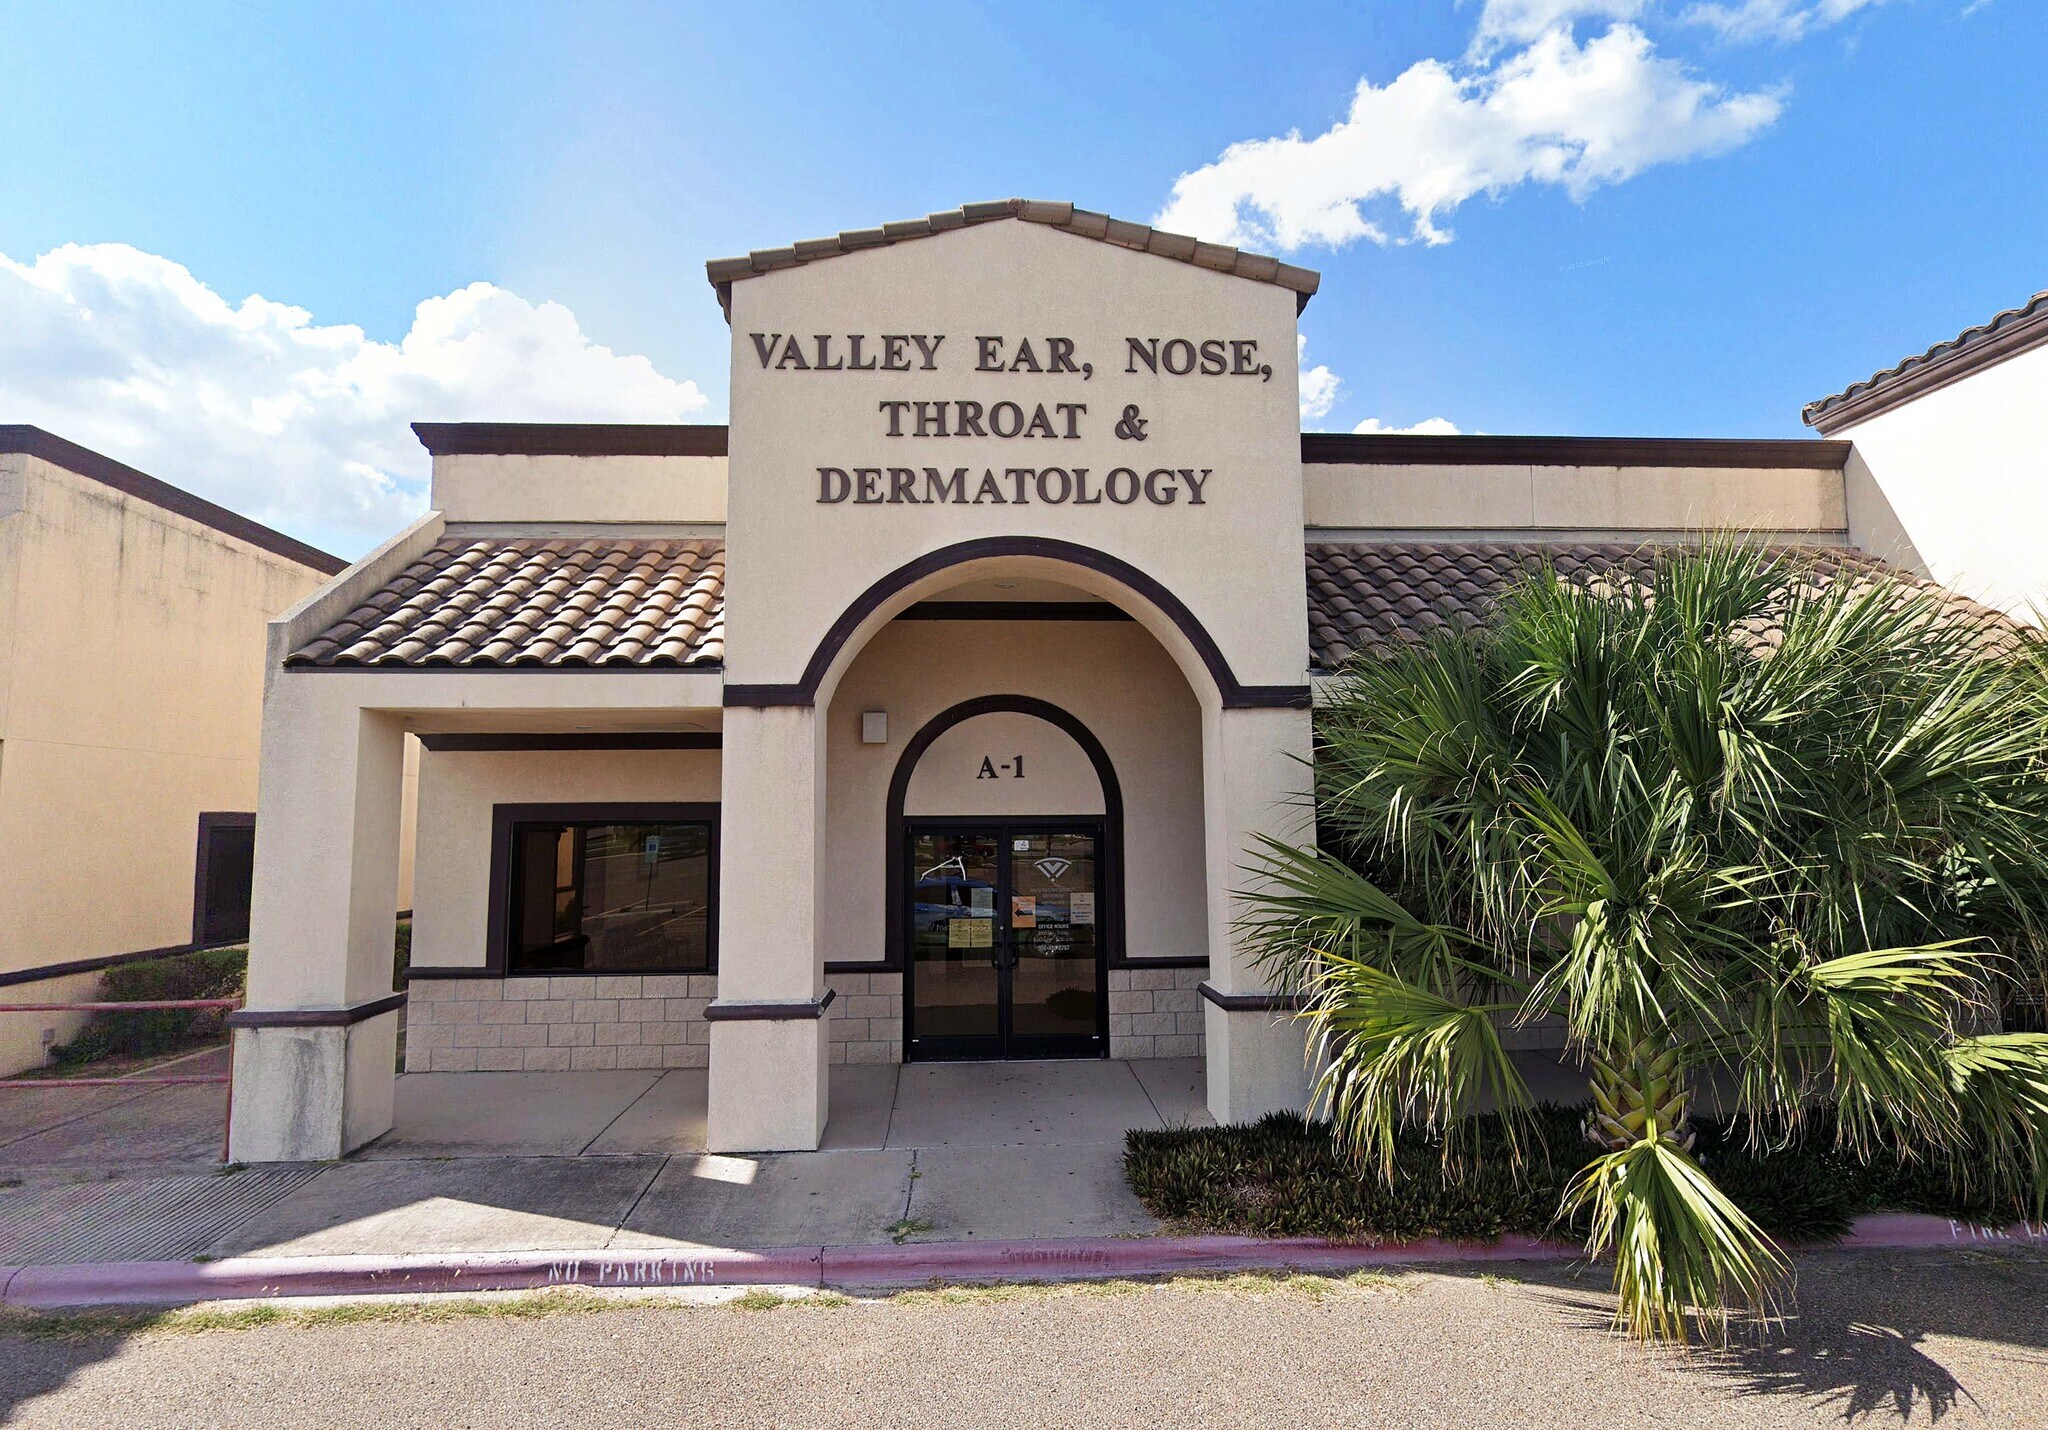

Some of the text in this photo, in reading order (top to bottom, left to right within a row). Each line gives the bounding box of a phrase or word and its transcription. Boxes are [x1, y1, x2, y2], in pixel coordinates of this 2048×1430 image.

[748, 332, 1273, 383] VALLEY EAR, NOSE,
[878, 399, 1149, 442] THROAT &
[815, 466, 1213, 506] DERMATOLOGY
[976, 755, 1025, 779] A-1
[549, 1260, 714, 1282] NO PARKING
